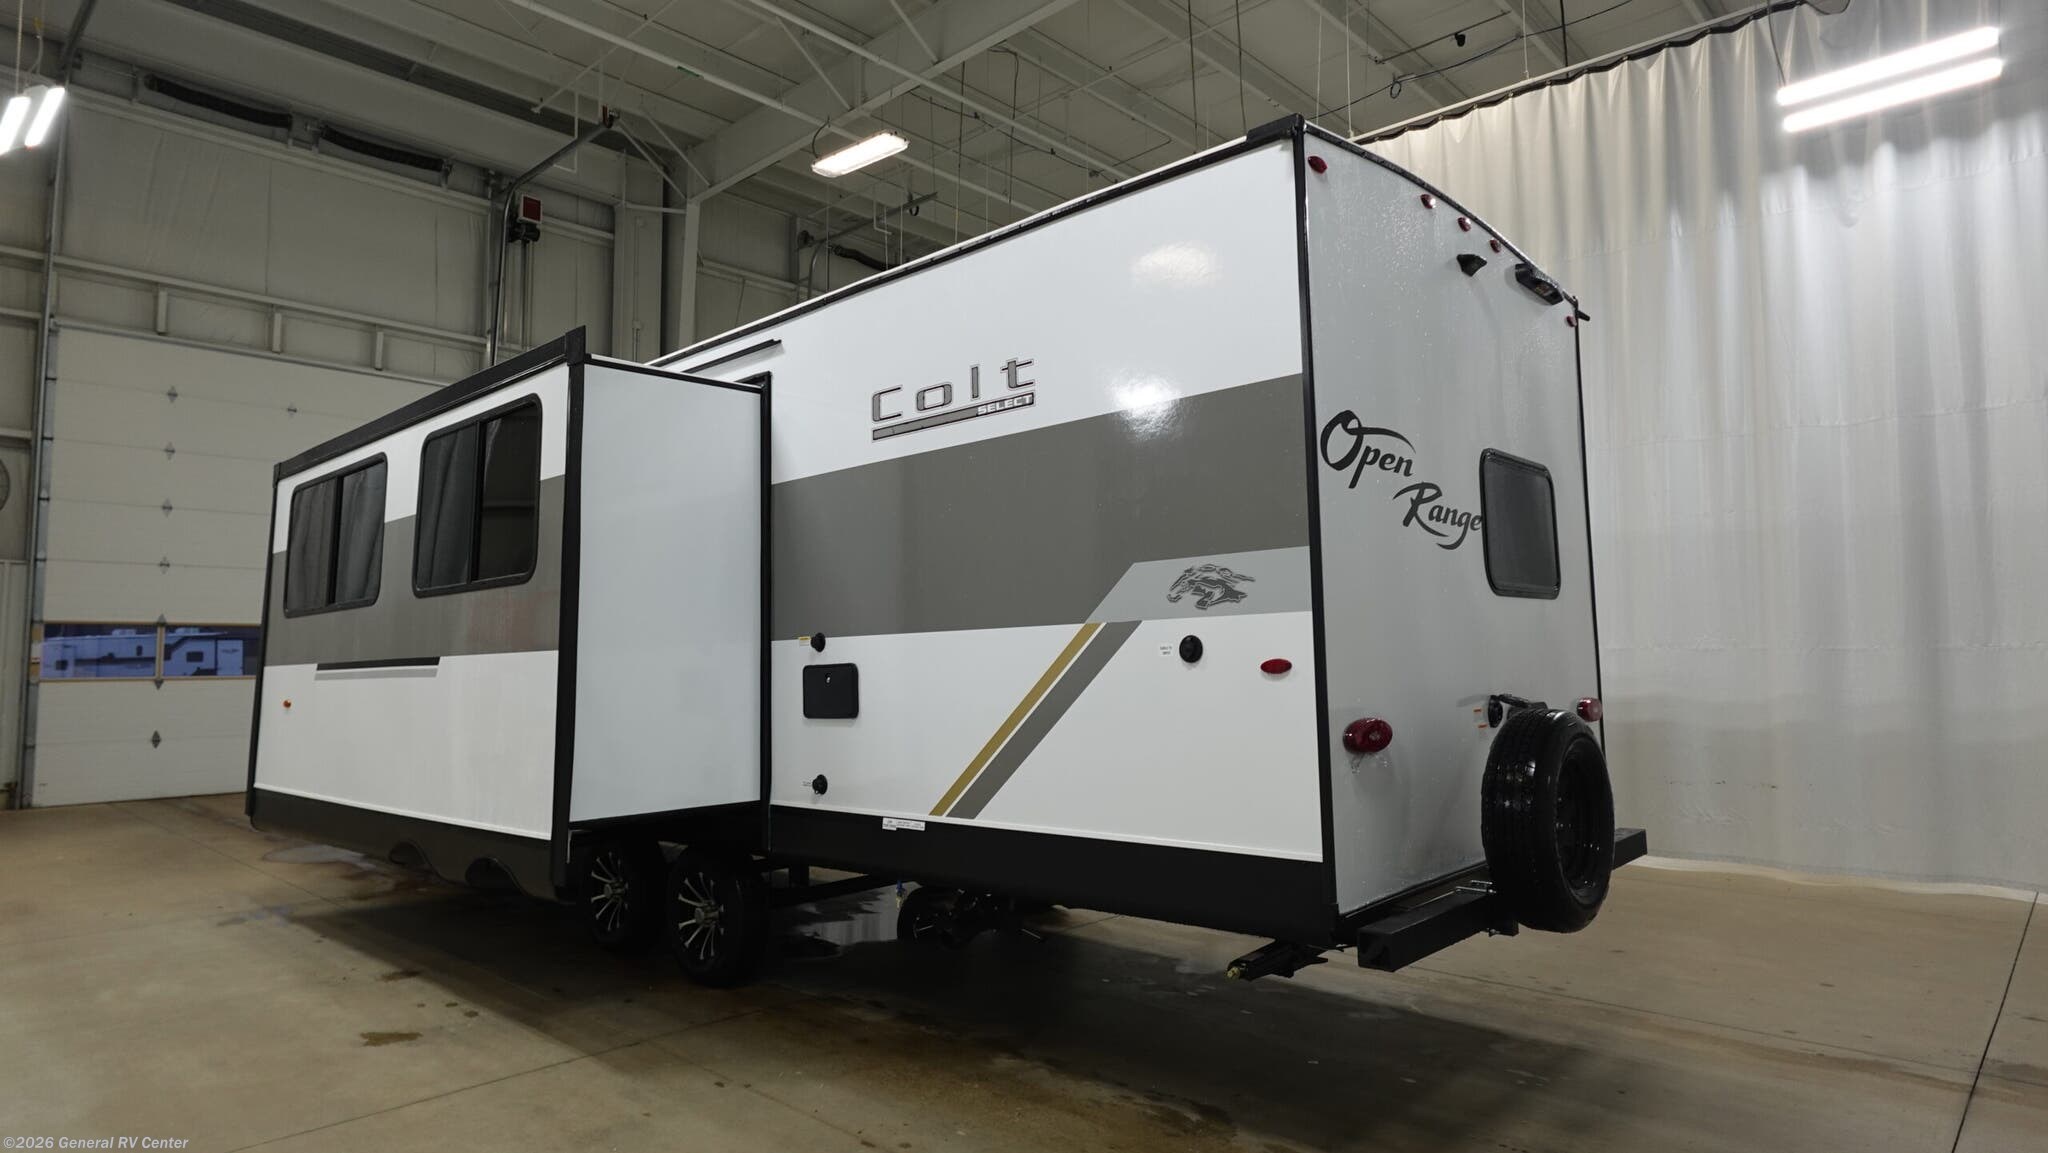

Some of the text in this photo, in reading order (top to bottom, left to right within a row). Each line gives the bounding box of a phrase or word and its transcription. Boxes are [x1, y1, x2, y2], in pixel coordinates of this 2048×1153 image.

[872, 359, 1034, 422] Colt
[977, 394, 1033, 416] SELECT
[1320, 410, 1416, 489] Open
[1392, 482, 1483, 550] Range
